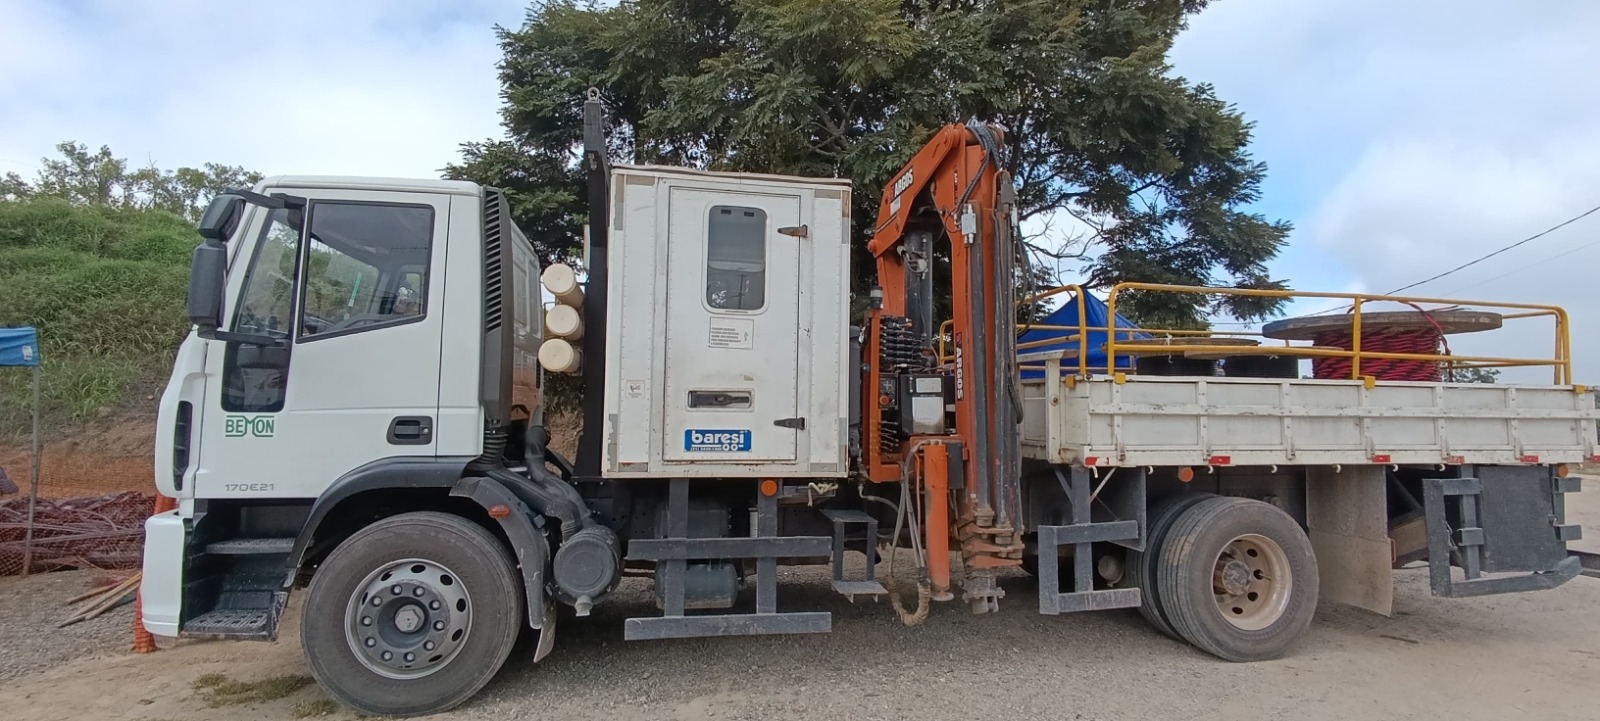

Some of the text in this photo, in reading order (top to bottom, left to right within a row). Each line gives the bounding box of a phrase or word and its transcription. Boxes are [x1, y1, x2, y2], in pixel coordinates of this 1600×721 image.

[894, 168, 913, 198] ARGOS
[956, 347, 964, 400] ARGOS
[225, 415, 275, 437] BEMON
[691, 430, 744, 444] baresi
[224, 483, 275, 492] 170E21
